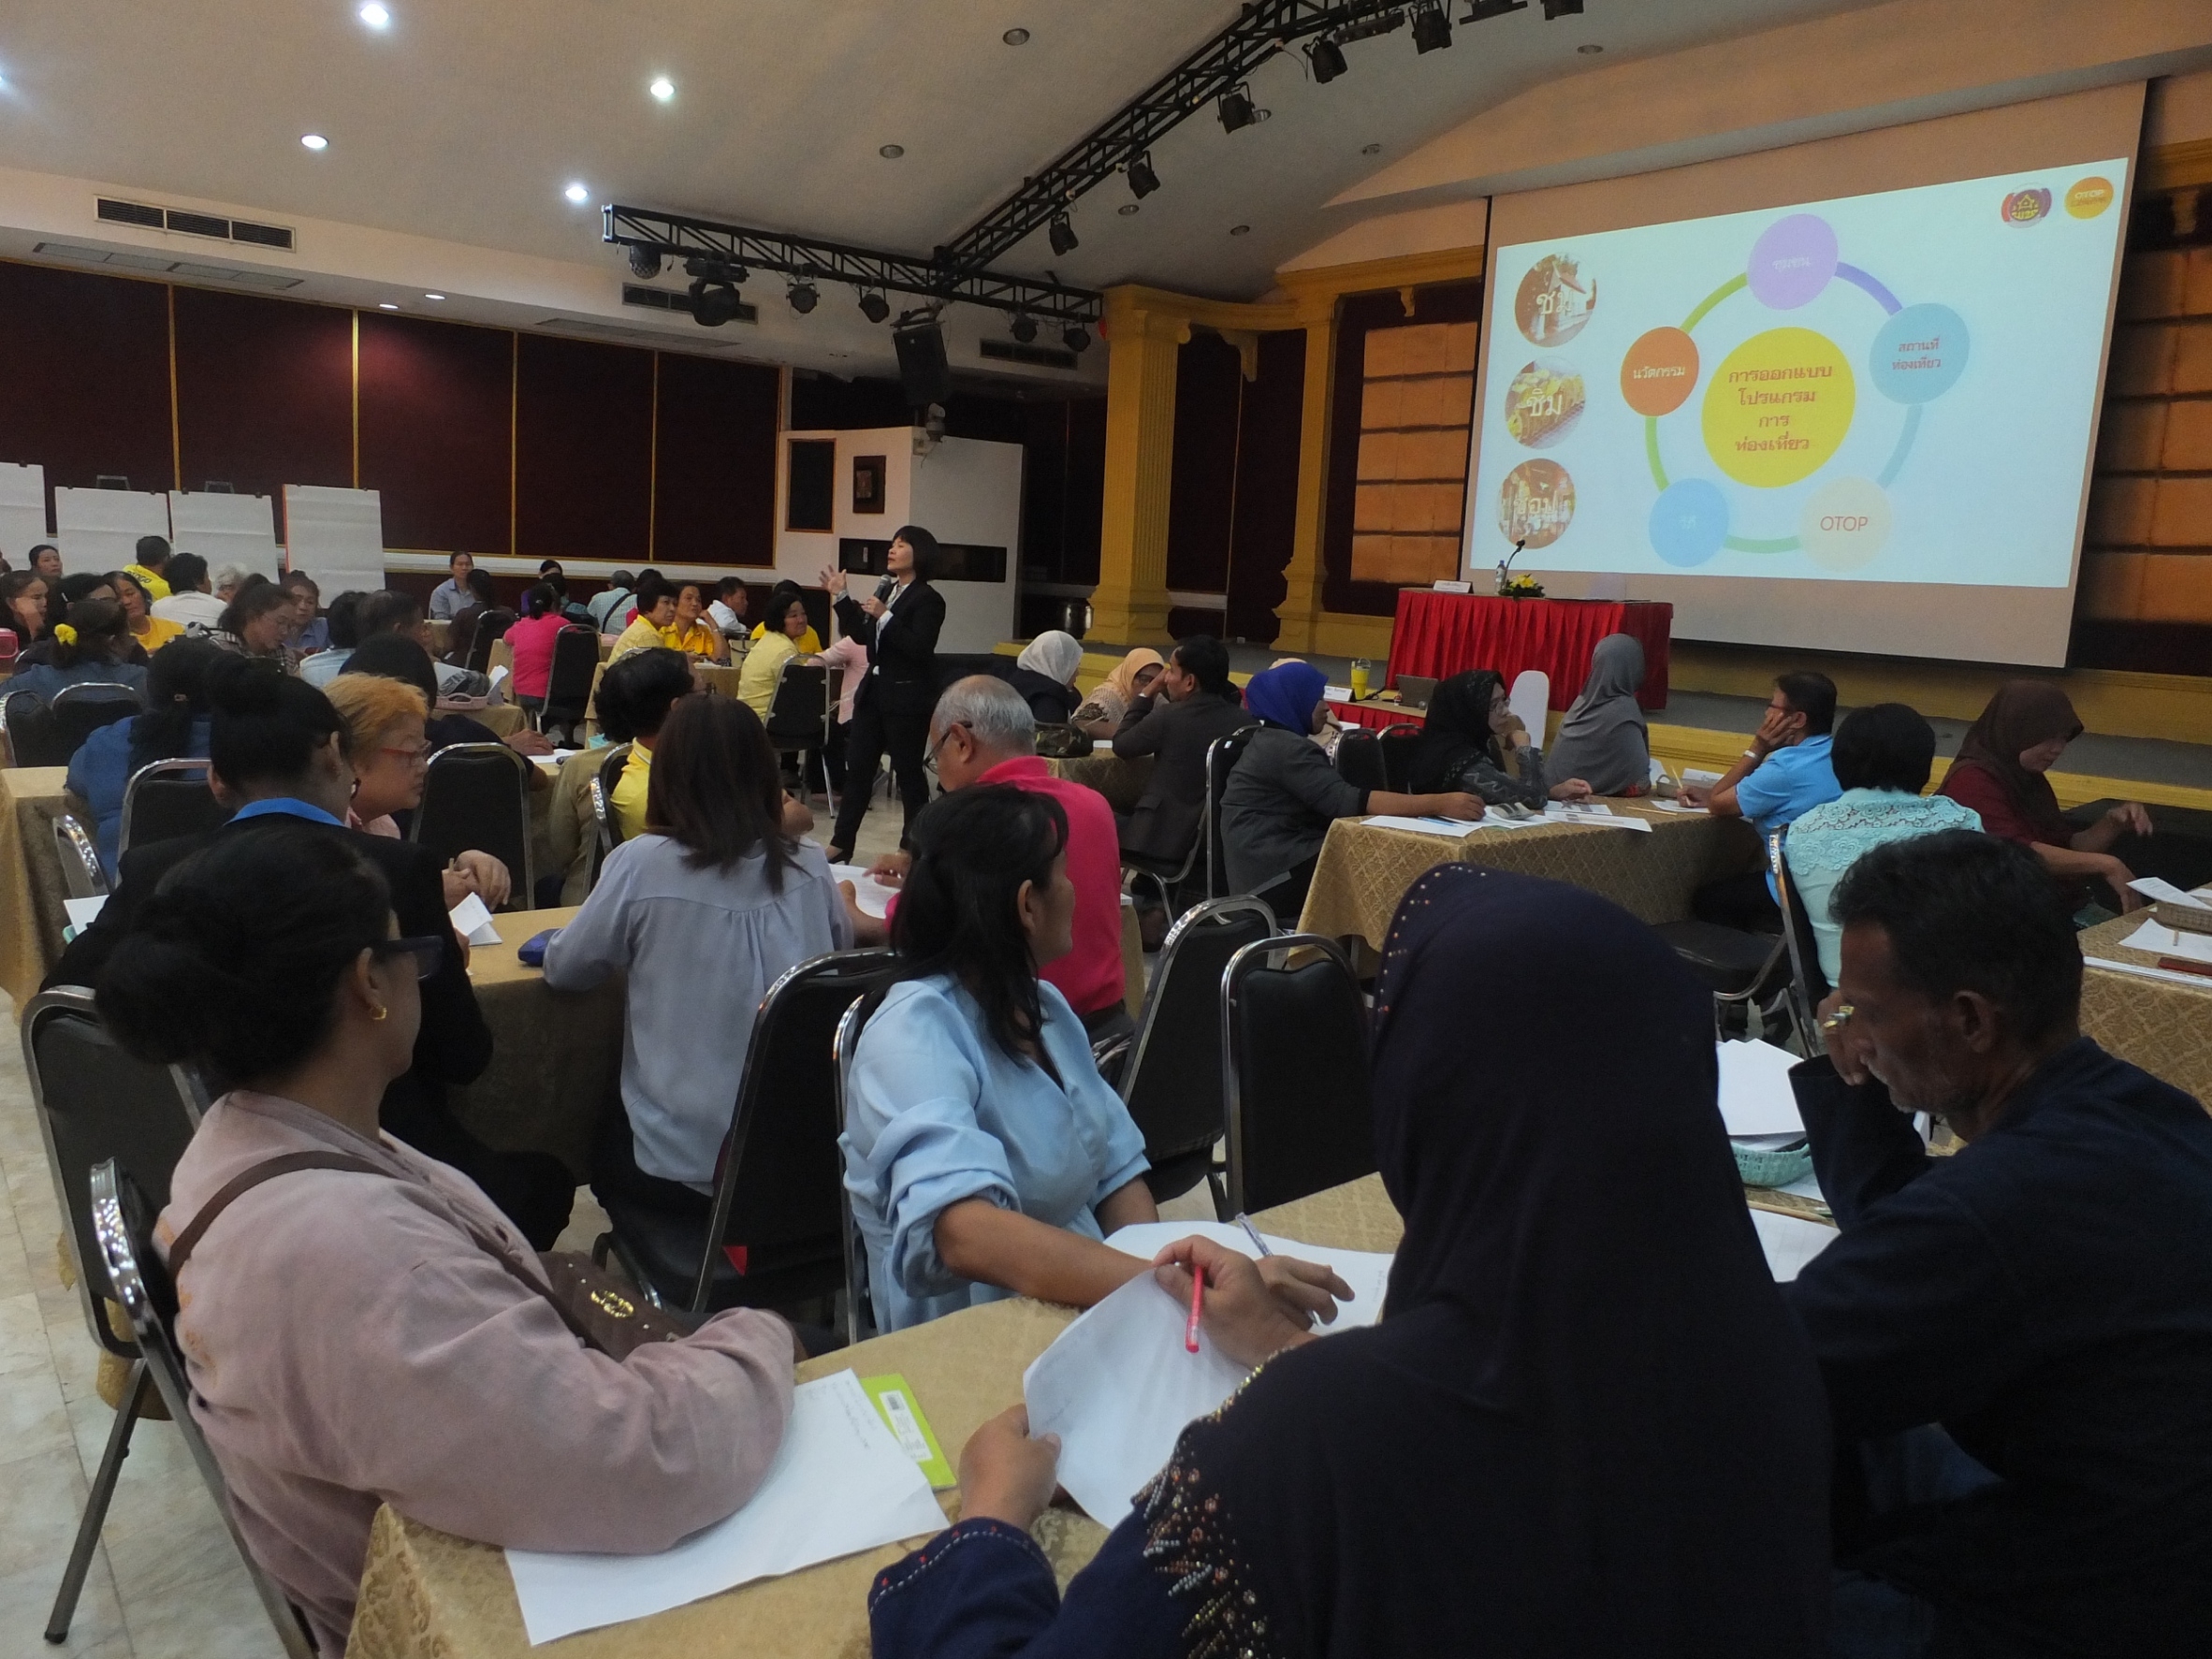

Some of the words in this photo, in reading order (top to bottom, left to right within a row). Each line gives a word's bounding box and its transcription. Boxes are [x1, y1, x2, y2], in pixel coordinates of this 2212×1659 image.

[1729, 366, 1832, 383] การออกแบบ
[1526, 387, 1563, 417] ชิม
[1738, 387, 1816, 405] โปรแกรม
[1758, 415, 1790, 428] การ
[1735, 430, 1810, 451] ท่องเที่ยว
[1820, 516, 1869, 531] OTOP
